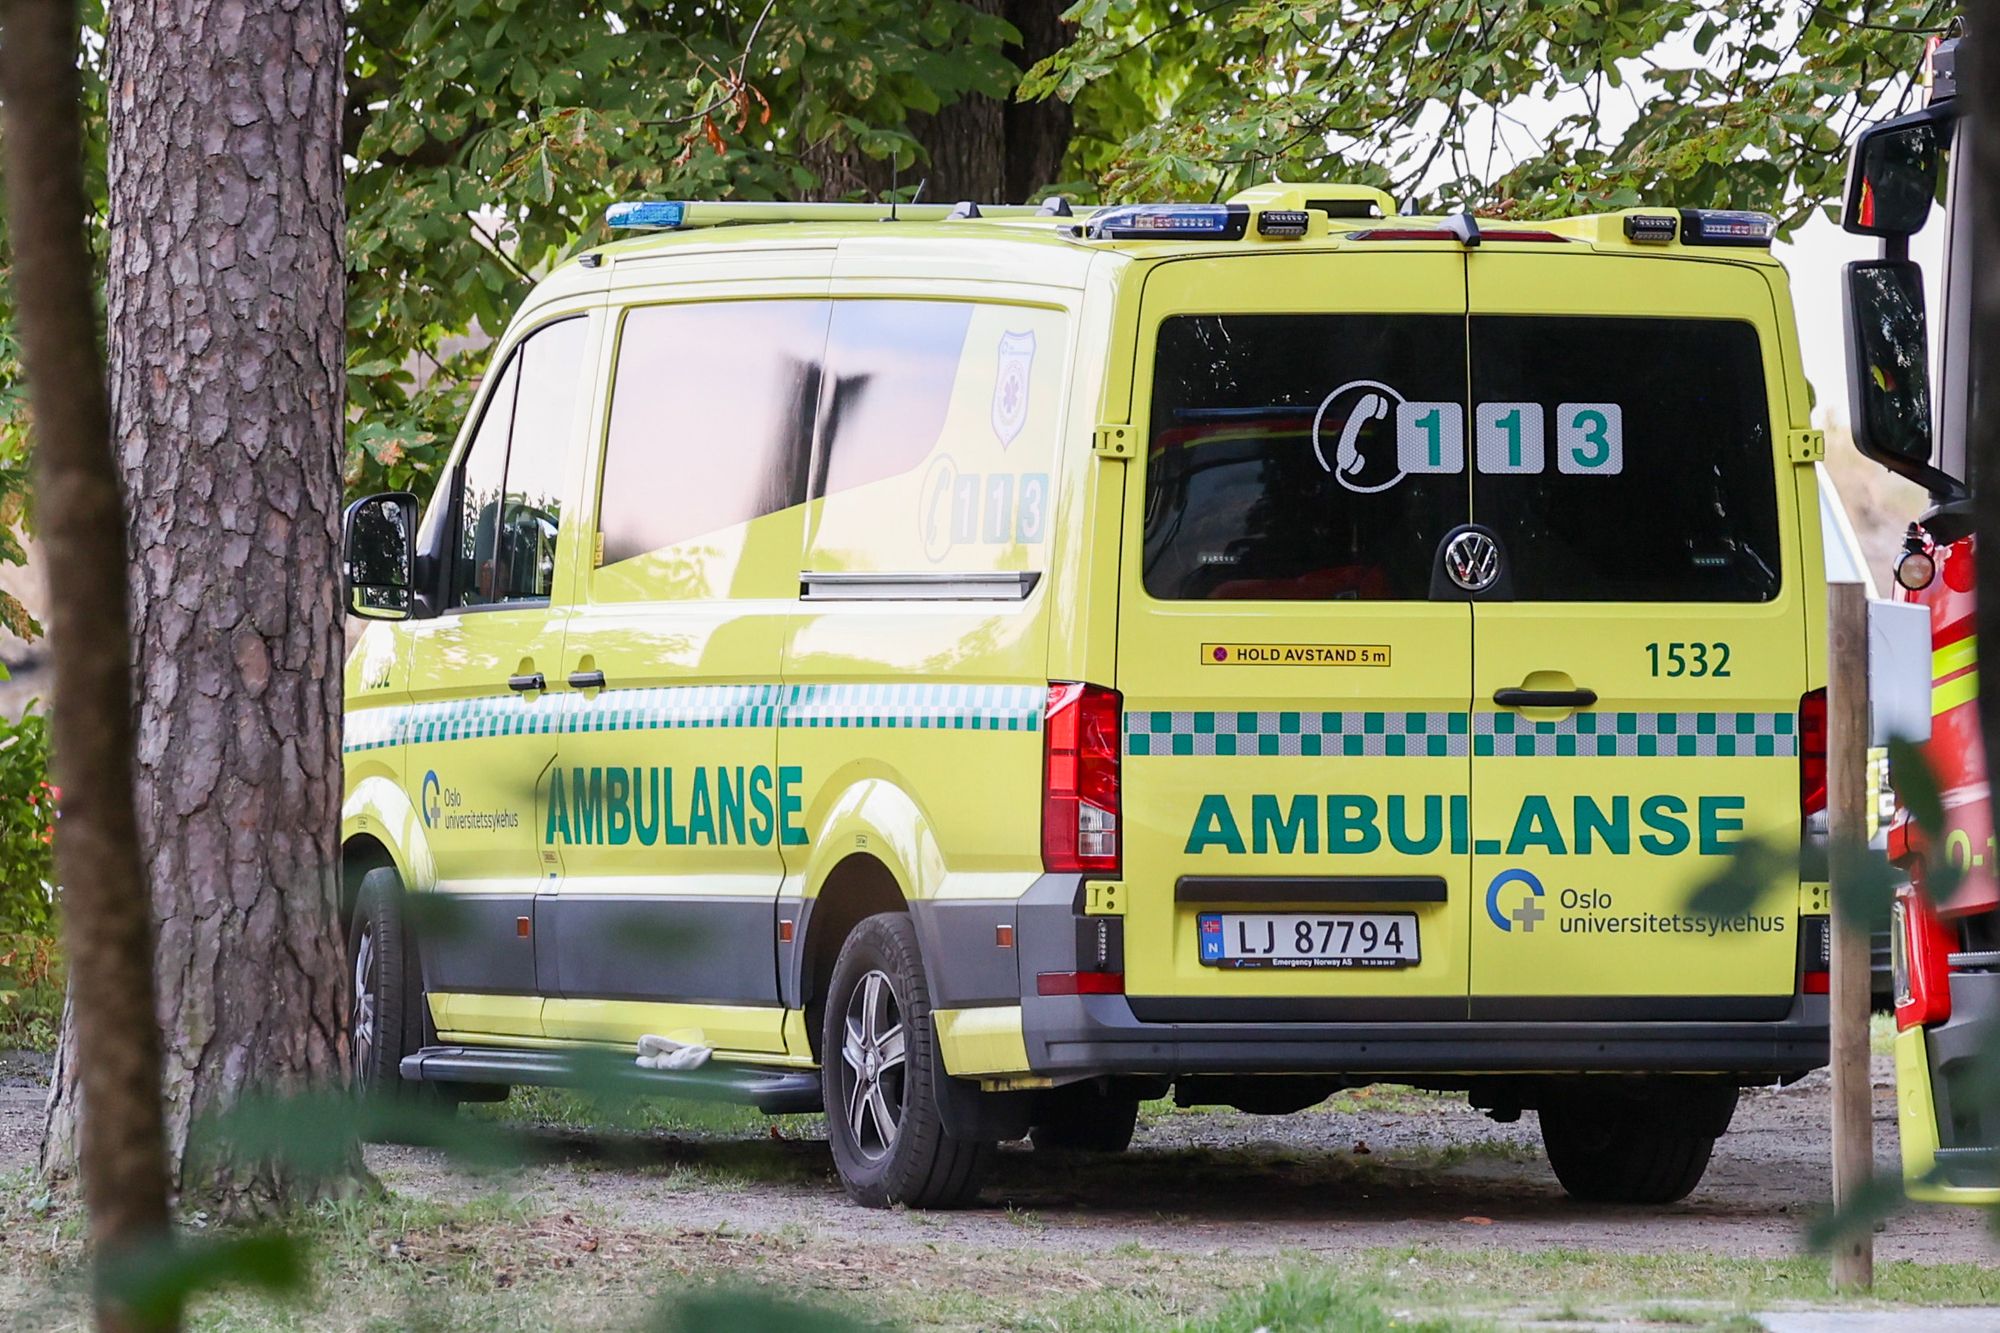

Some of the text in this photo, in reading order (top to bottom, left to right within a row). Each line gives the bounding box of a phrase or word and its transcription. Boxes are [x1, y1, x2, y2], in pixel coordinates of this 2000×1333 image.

[1237, 648, 1386, 662] HOLD AVSTAND 5 m
[1645, 642, 1731, 677] 1532
[444, 787, 461, 807] Oslo
[545, 765, 810, 846] AMBULANSE
[444, 808, 519, 832] universitetssykehus
[1184, 794, 1746, 855] AMBULANSE
[1560, 888, 1612, 909] Oslo
[1560, 912, 1785, 937] universitetssykehus
[1208, 942, 1219, 953] N
[1238, 920, 1404, 955] LJ 87794
[1272, 958, 1312, 968] Emergency
[1313, 958, 1341, 968] Norway
[1341, 958, 1353, 967] AS
